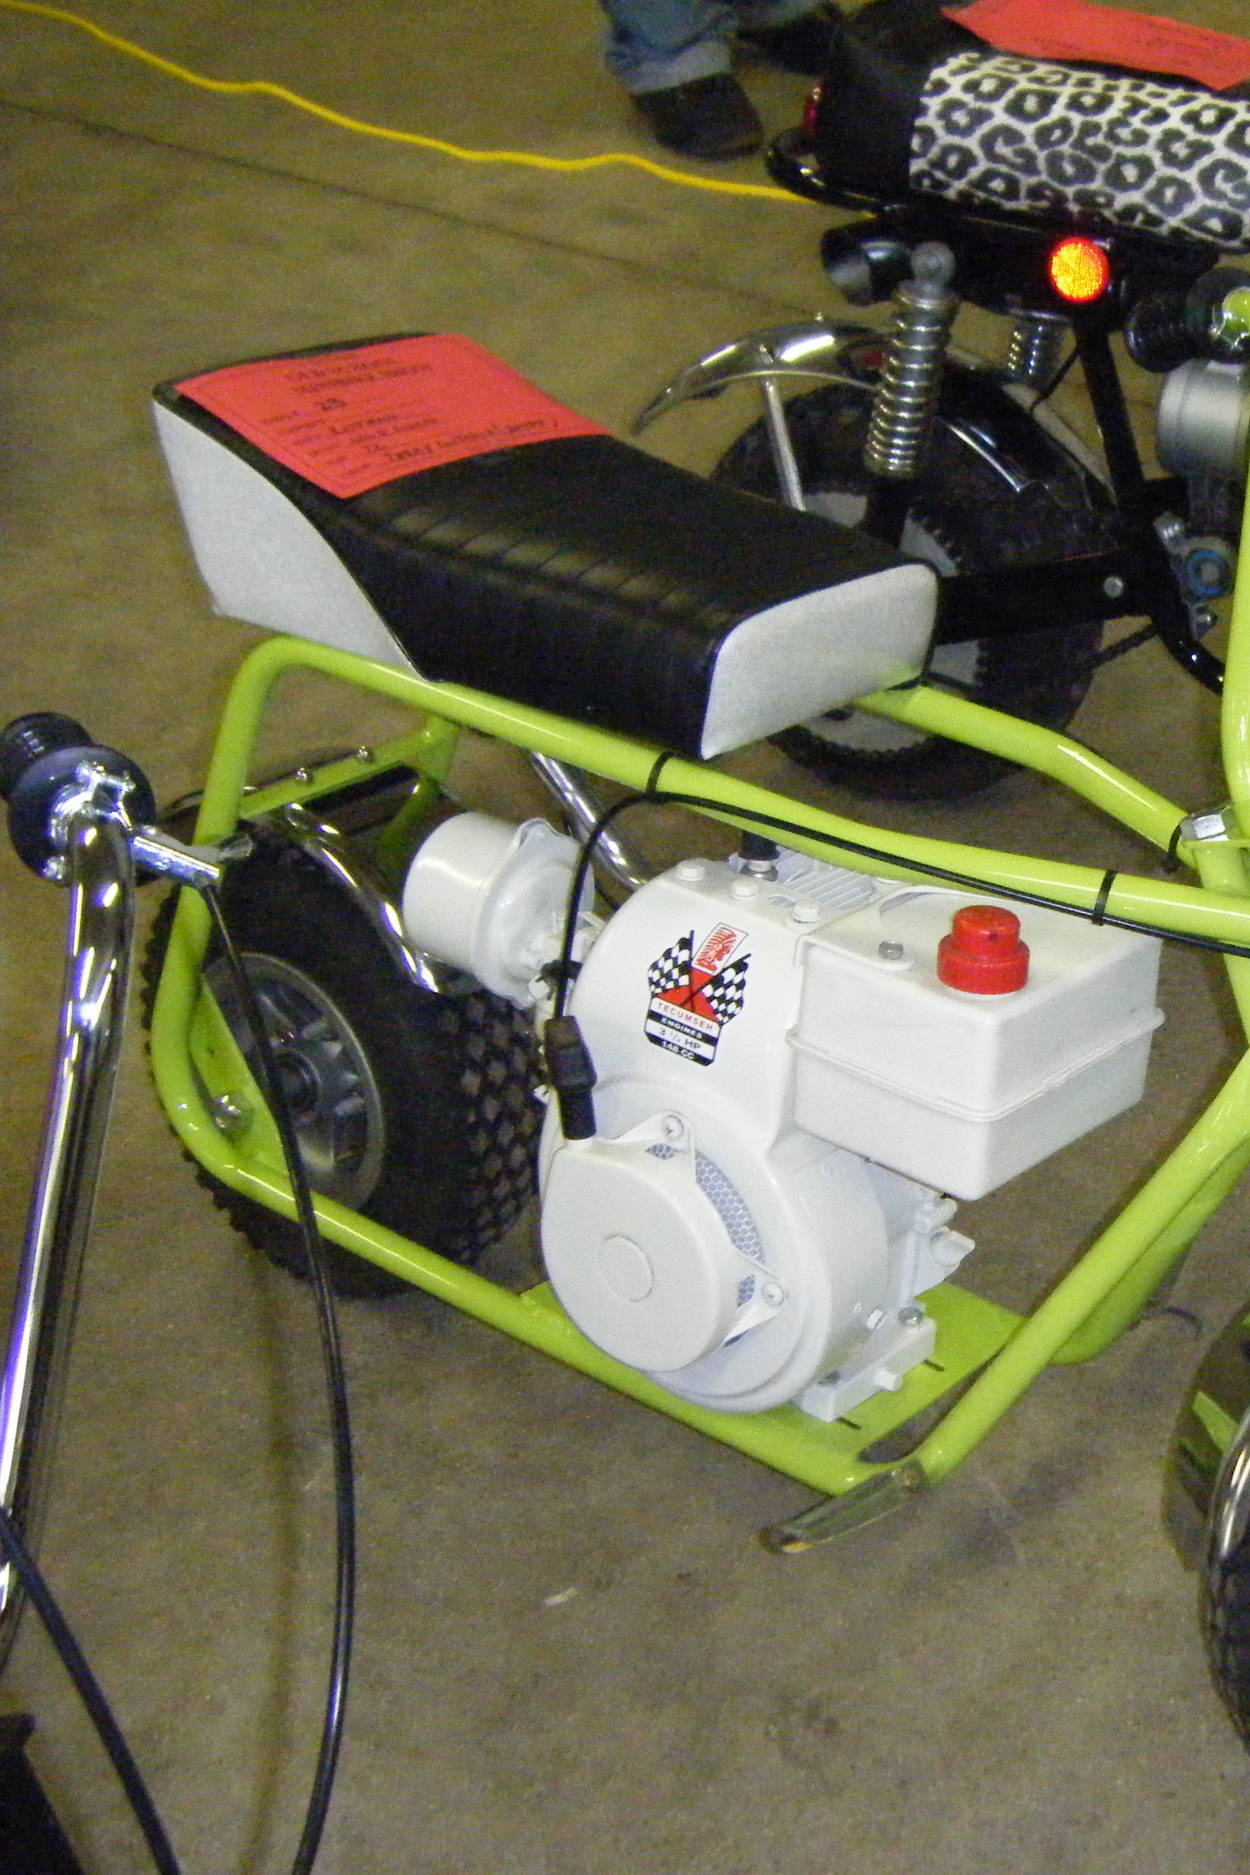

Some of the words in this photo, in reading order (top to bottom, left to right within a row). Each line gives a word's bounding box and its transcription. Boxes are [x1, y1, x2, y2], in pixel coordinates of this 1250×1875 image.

[657, 1002, 713, 1030] TECUMSEH
[661, 1018, 702, 1039] ENGINES
[684, 1039, 701, 1049] HP
[681, 1047, 695, 1059] CC
